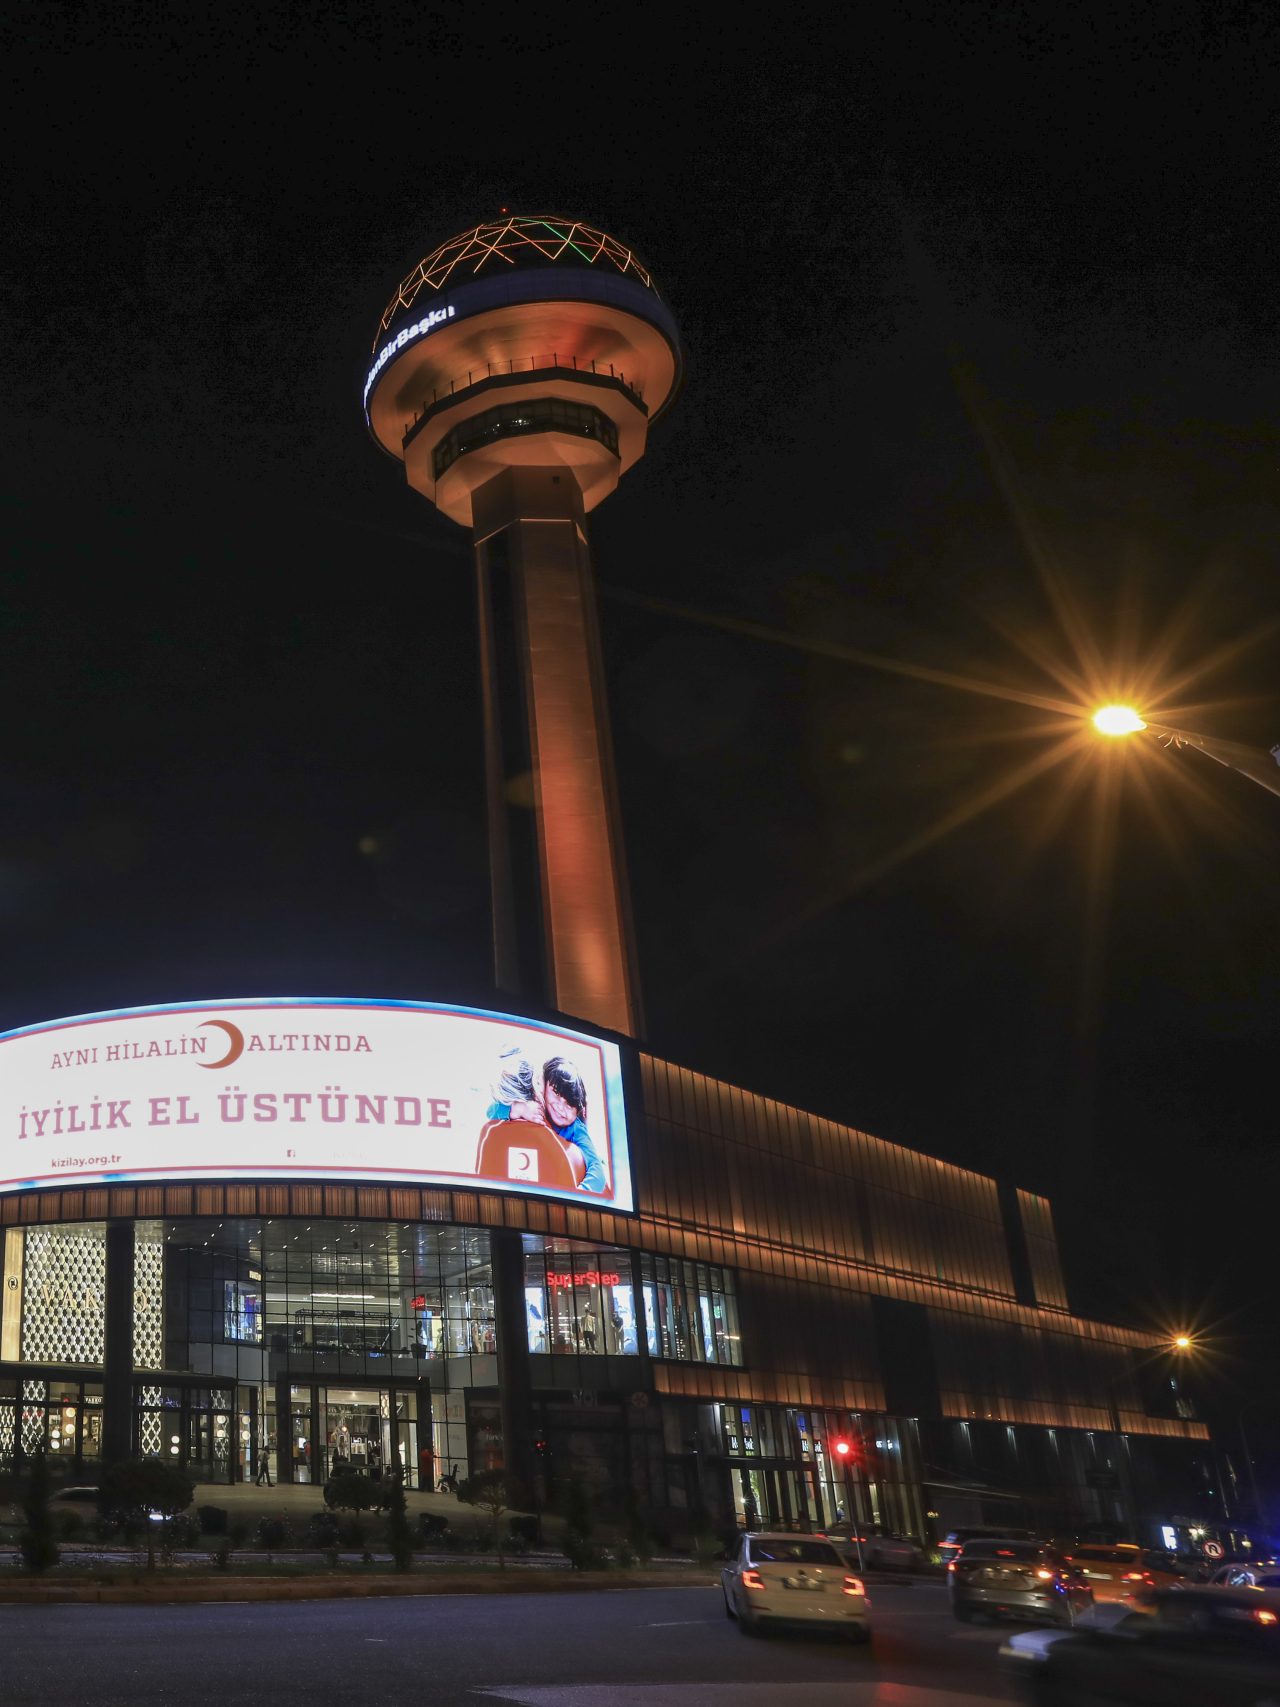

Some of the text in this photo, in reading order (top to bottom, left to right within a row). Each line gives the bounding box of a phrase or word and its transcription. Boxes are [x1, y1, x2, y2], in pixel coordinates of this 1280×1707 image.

[50, 1034, 373, 1069] AYNI HİLALİN ALTINDA
[18, 1086, 452, 1139] İYİLİK EL ÜSTÜNDE
[51, 1154, 122, 1168] kizilay.org.tr
[547, 1271, 620, 1288] SuperStep
[42, 1284, 147, 1312] VAKO
